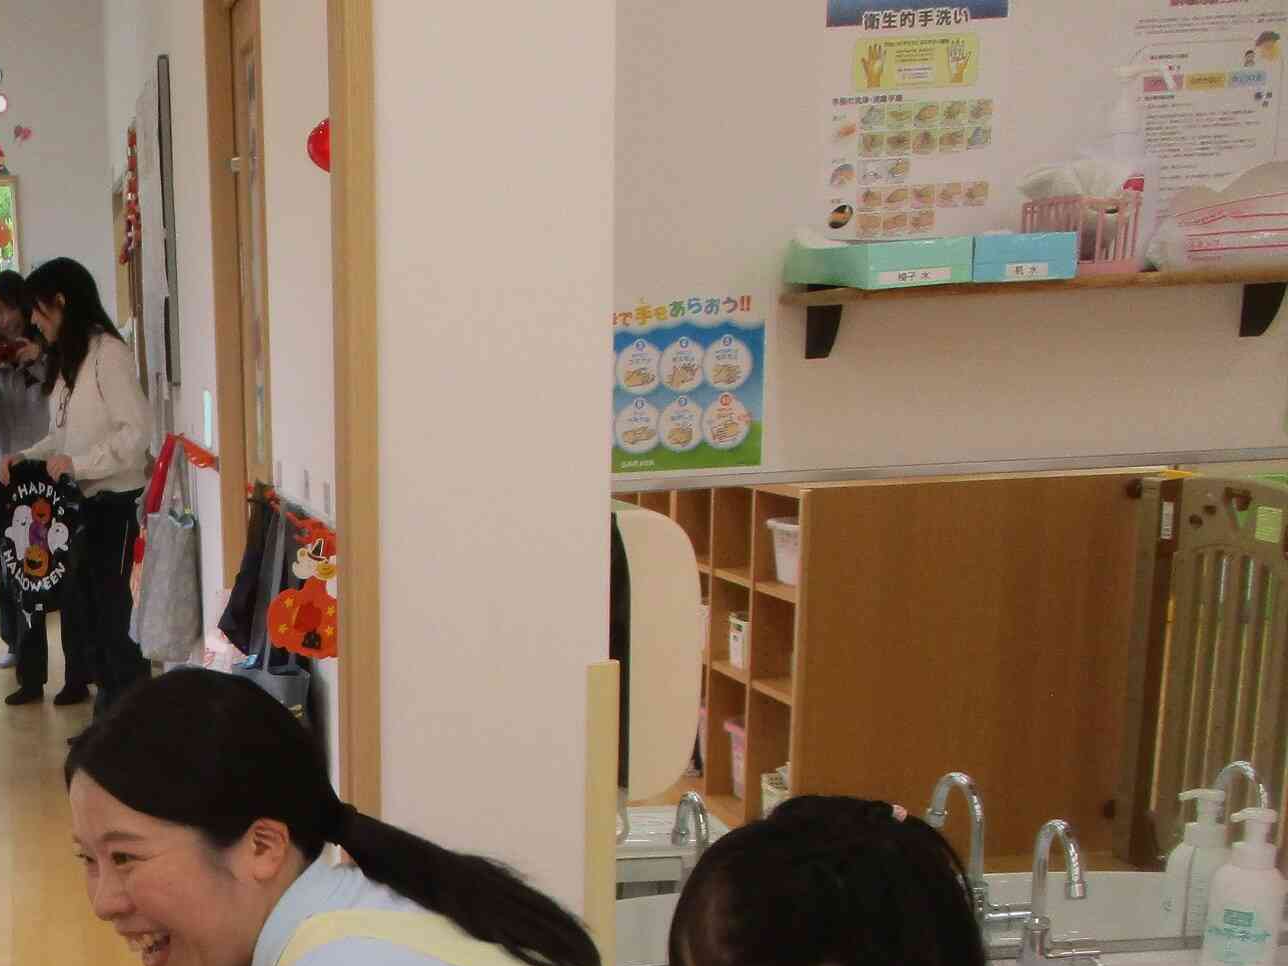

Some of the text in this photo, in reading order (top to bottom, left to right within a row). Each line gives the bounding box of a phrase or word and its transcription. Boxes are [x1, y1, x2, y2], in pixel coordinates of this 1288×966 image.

[864, 8, 969, 31] 衛生的手洗い
[17, 481, 60, 506] HAPPY
[3, 549, 66, 592] HALLOWEEN
